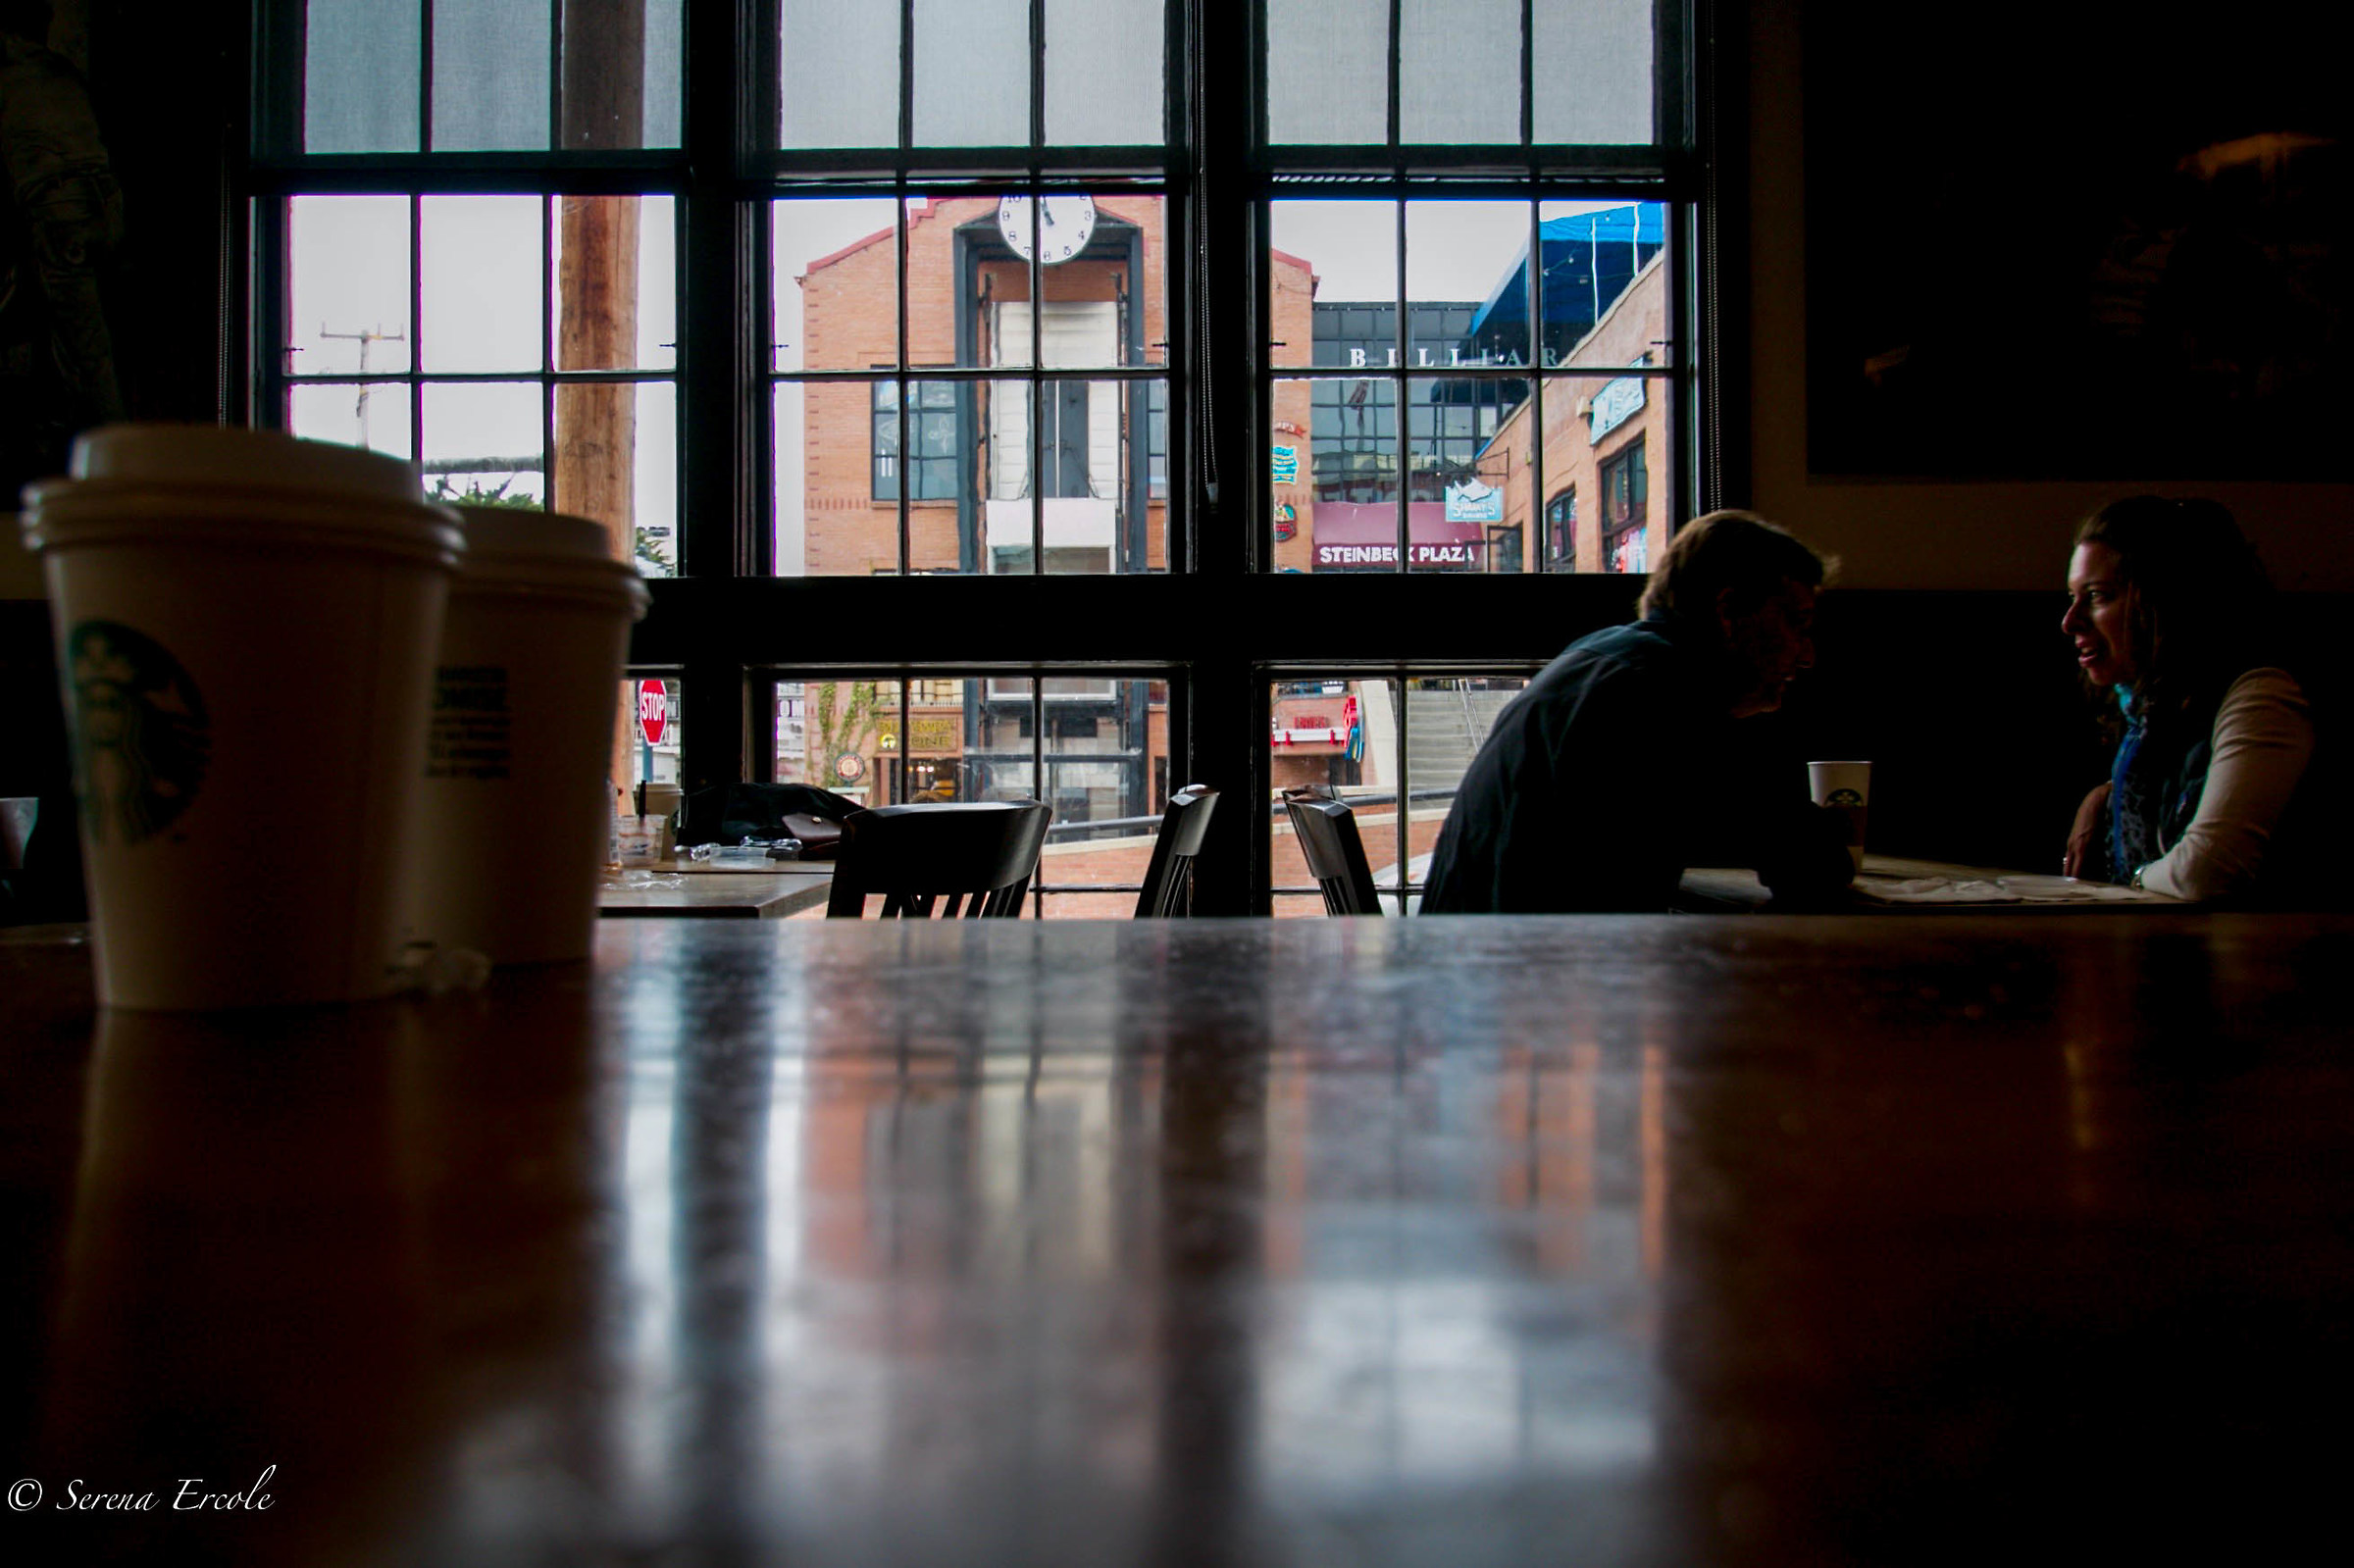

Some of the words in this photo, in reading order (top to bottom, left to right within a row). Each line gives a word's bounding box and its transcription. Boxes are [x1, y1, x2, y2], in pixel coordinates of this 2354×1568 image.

[1002, 211, 1010, 222] 9
[1084, 211, 1092, 222] 3
[1008, 231, 1017, 242] 8
[1078, 230, 1085, 240] 4
[1063, 245, 1072, 256] 5
[1043, 251, 1050, 262] 6
[1418, 546, 1475, 562] PLAZA
[641, 691, 665, 722] STOP
